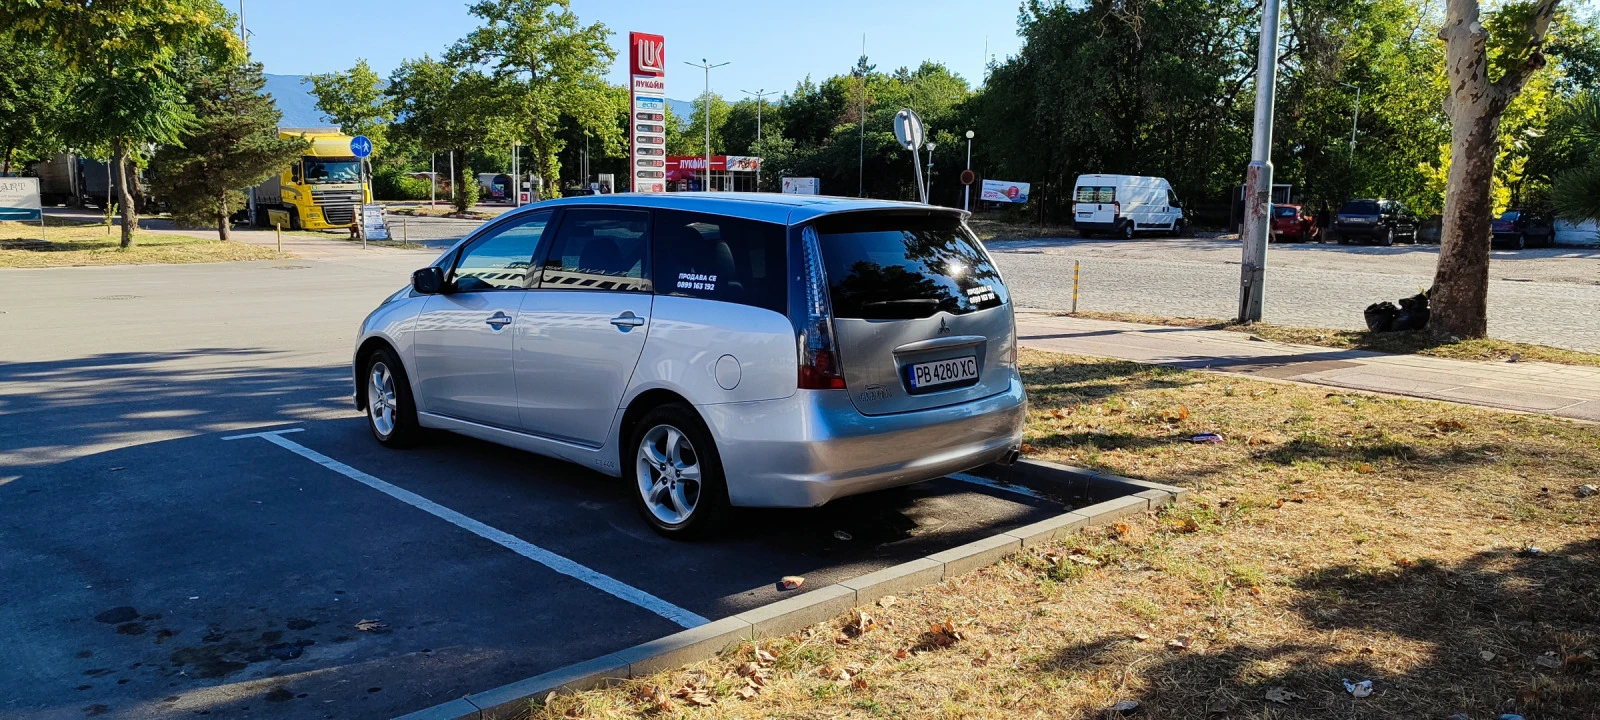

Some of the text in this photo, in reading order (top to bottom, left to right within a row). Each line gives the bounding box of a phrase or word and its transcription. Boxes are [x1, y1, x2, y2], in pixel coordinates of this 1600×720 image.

[635, 80, 664, 90] ЛУКОЙЛ
[642, 101, 658, 109] ecto
[679, 157, 707, 169] ЛУКОЙЛ
[678, 273, 717, 282] ПРОДАВА СЕ
[677, 281, 715, 291] 0899 163 192
[916, 359, 976, 385] PB 4280 XC
